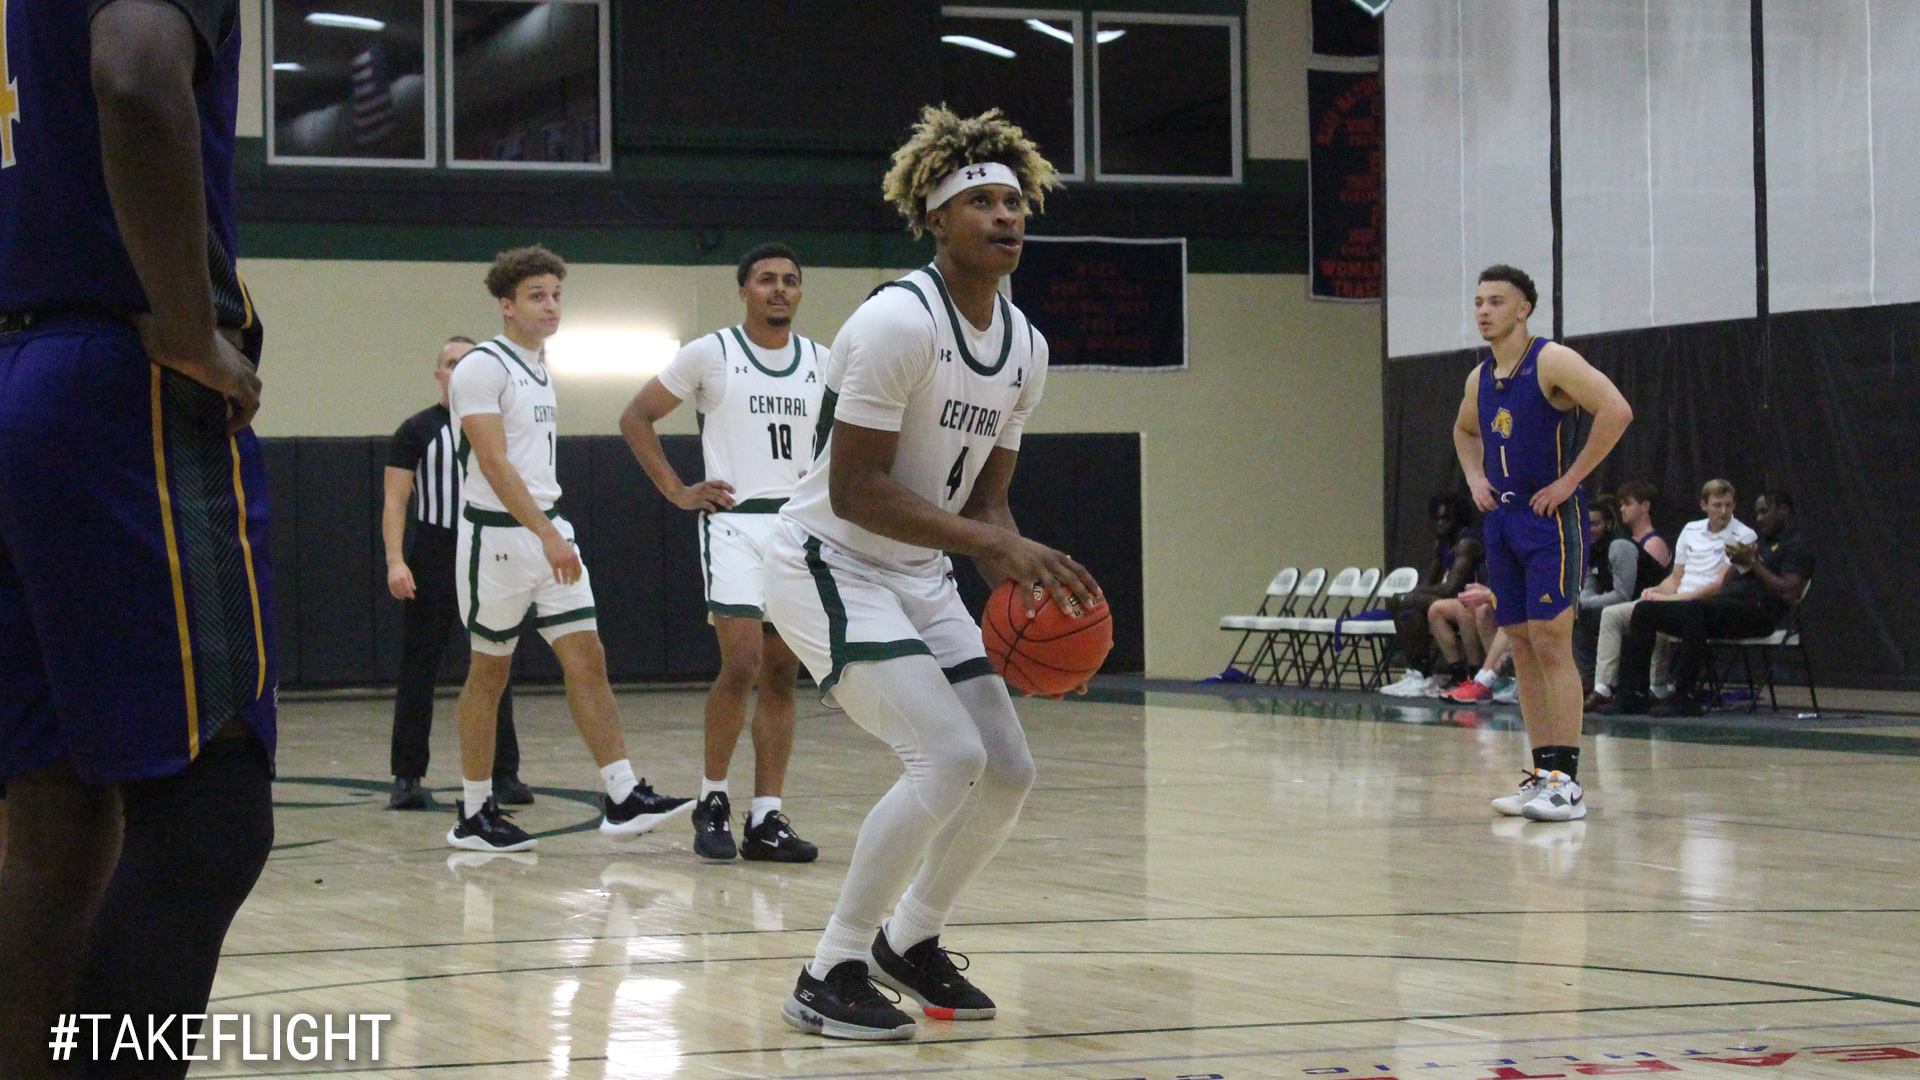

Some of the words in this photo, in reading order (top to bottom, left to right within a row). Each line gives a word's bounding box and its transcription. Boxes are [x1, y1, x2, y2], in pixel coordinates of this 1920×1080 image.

[749, 395, 808, 417] CENTRAL
[939, 399, 1002, 438] CENTRAL
[547, 431, 553, 466] 1
[767, 422, 793, 461] 10
[946, 446, 970, 501] 4
[1500, 445, 1510, 478] 1
